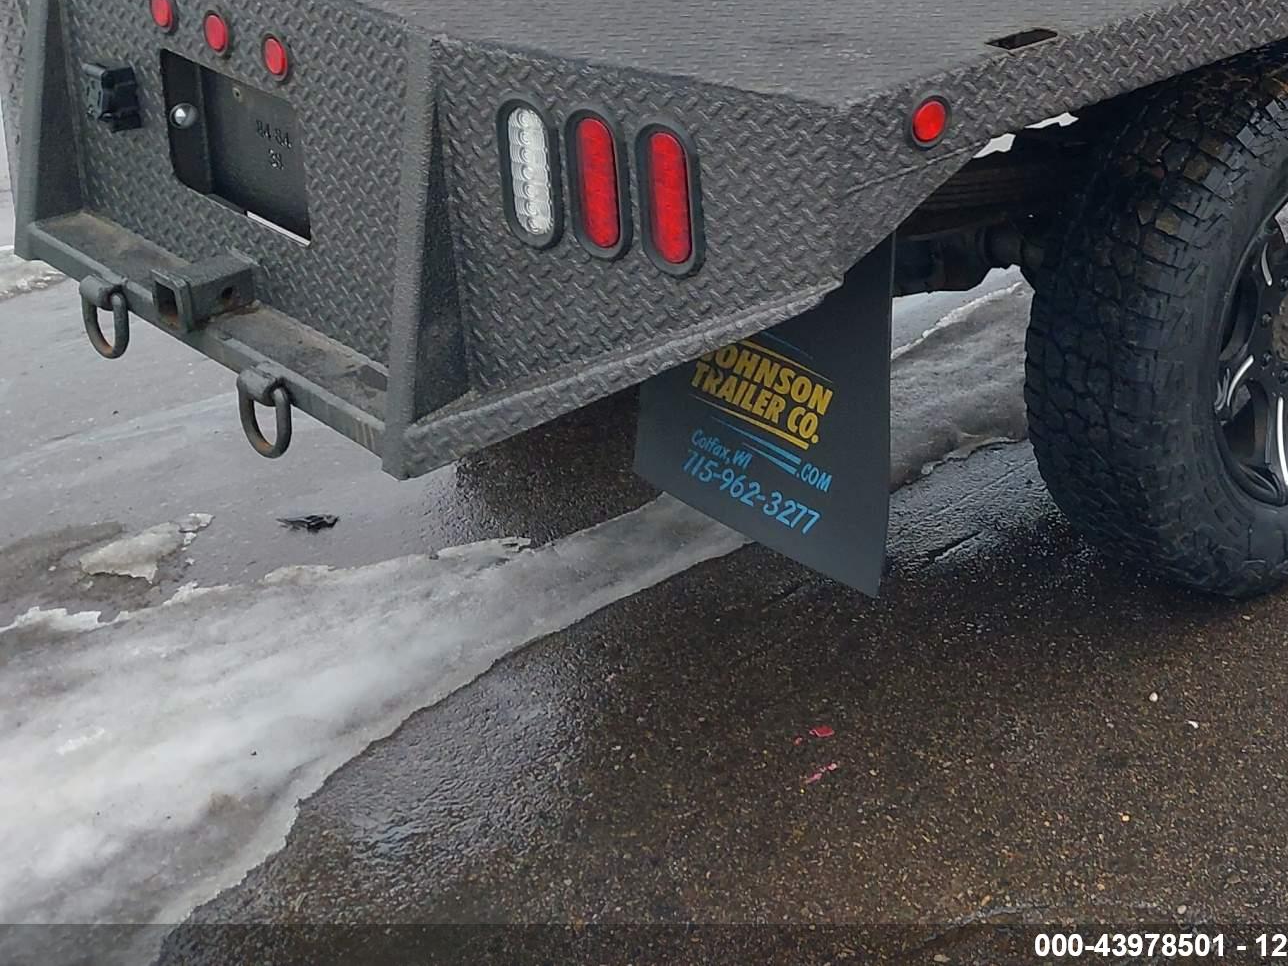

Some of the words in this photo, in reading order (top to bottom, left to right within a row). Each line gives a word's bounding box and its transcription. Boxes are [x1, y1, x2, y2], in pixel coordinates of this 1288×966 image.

[691, 361, 787, 424] TRAILER
[787, 406, 820, 444] CO.
[683, 449, 821, 534] 715-962-3277
[796, 463, 833, 492] .COM
